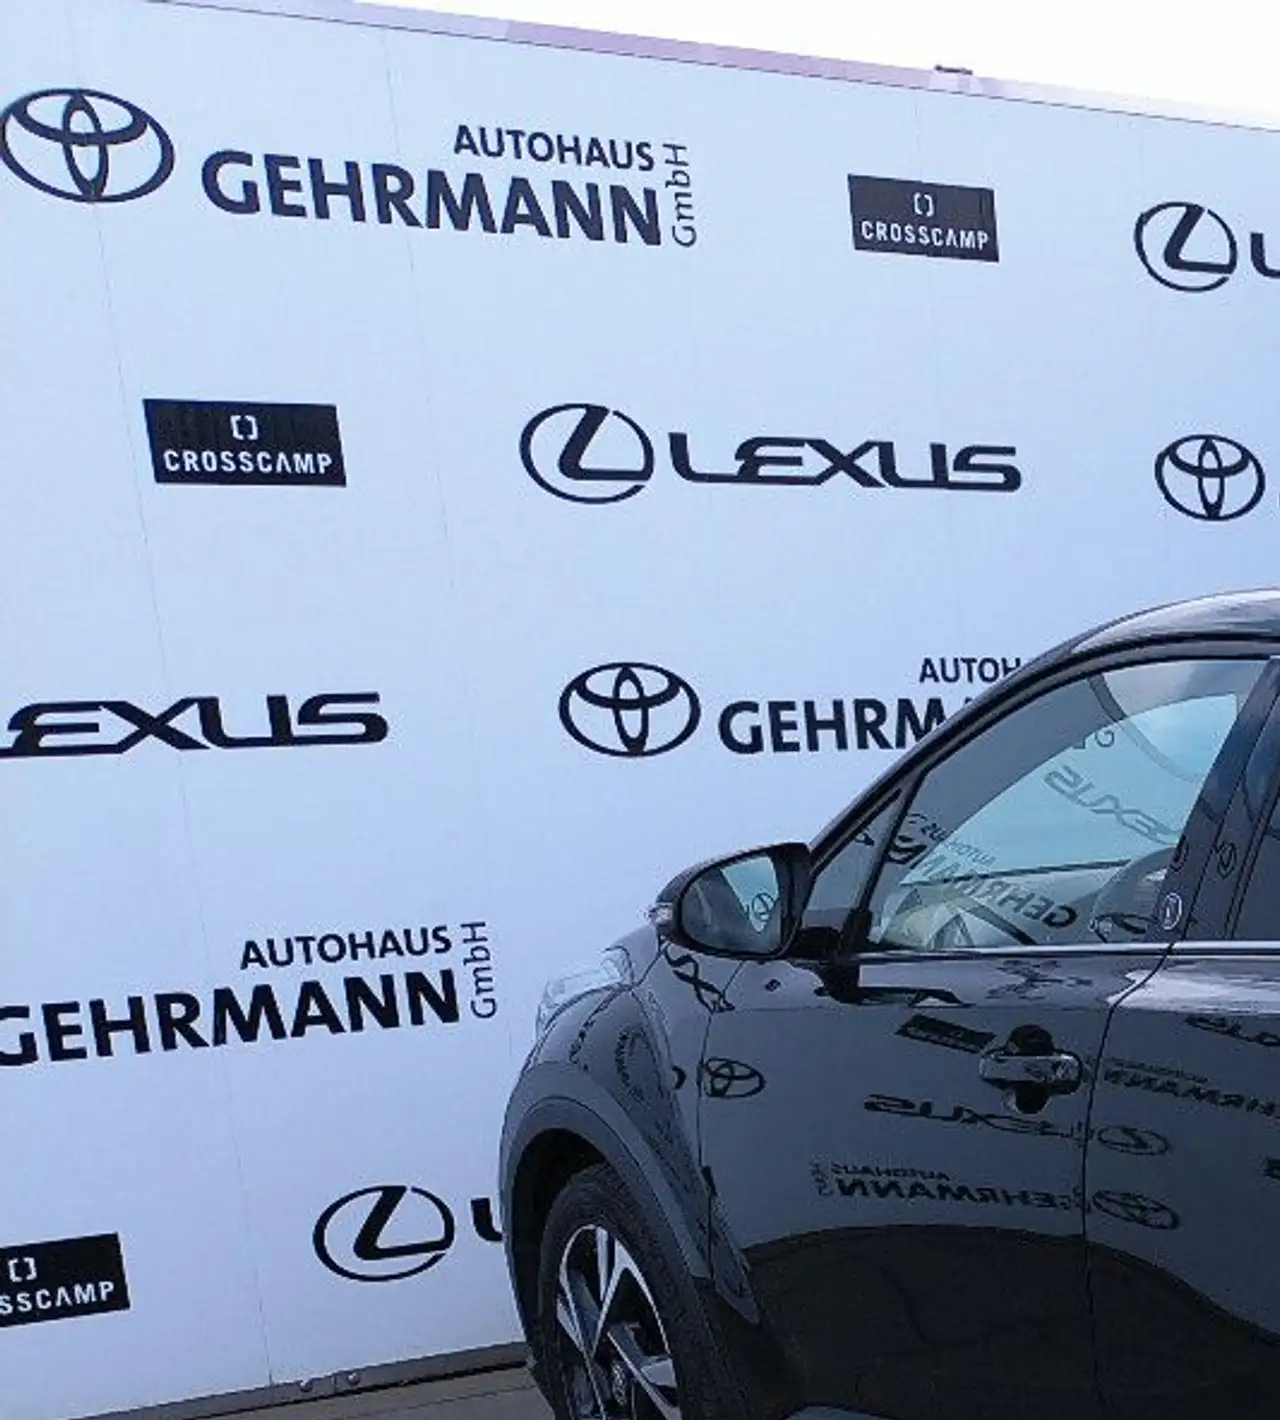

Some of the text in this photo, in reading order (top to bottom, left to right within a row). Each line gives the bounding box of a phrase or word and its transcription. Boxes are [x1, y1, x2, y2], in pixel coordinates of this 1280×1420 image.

[453, 124, 655, 173] AUTOHAUS
[200, 150, 662, 247] GEHRMANN
[664, 142, 698, 248] GmbH
[860, 220, 990, 253] CROSSCAMP
[163, 450, 333, 475] CROSSCAMP
[668, 432, 1023, 493] LEXUS
[919, 657, 1022, 683] AUTOH
[0, 692, 389, 758] EXUS
[718, 697, 977, 755] GEHRM
[239, 925, 452, 970] AUTOHAUS
[460, 921, 498, 1020] GmbH
[0, 969, 461, 1067] GEHRMANN
[0, 1280, 116, 1315] SSCAMP
